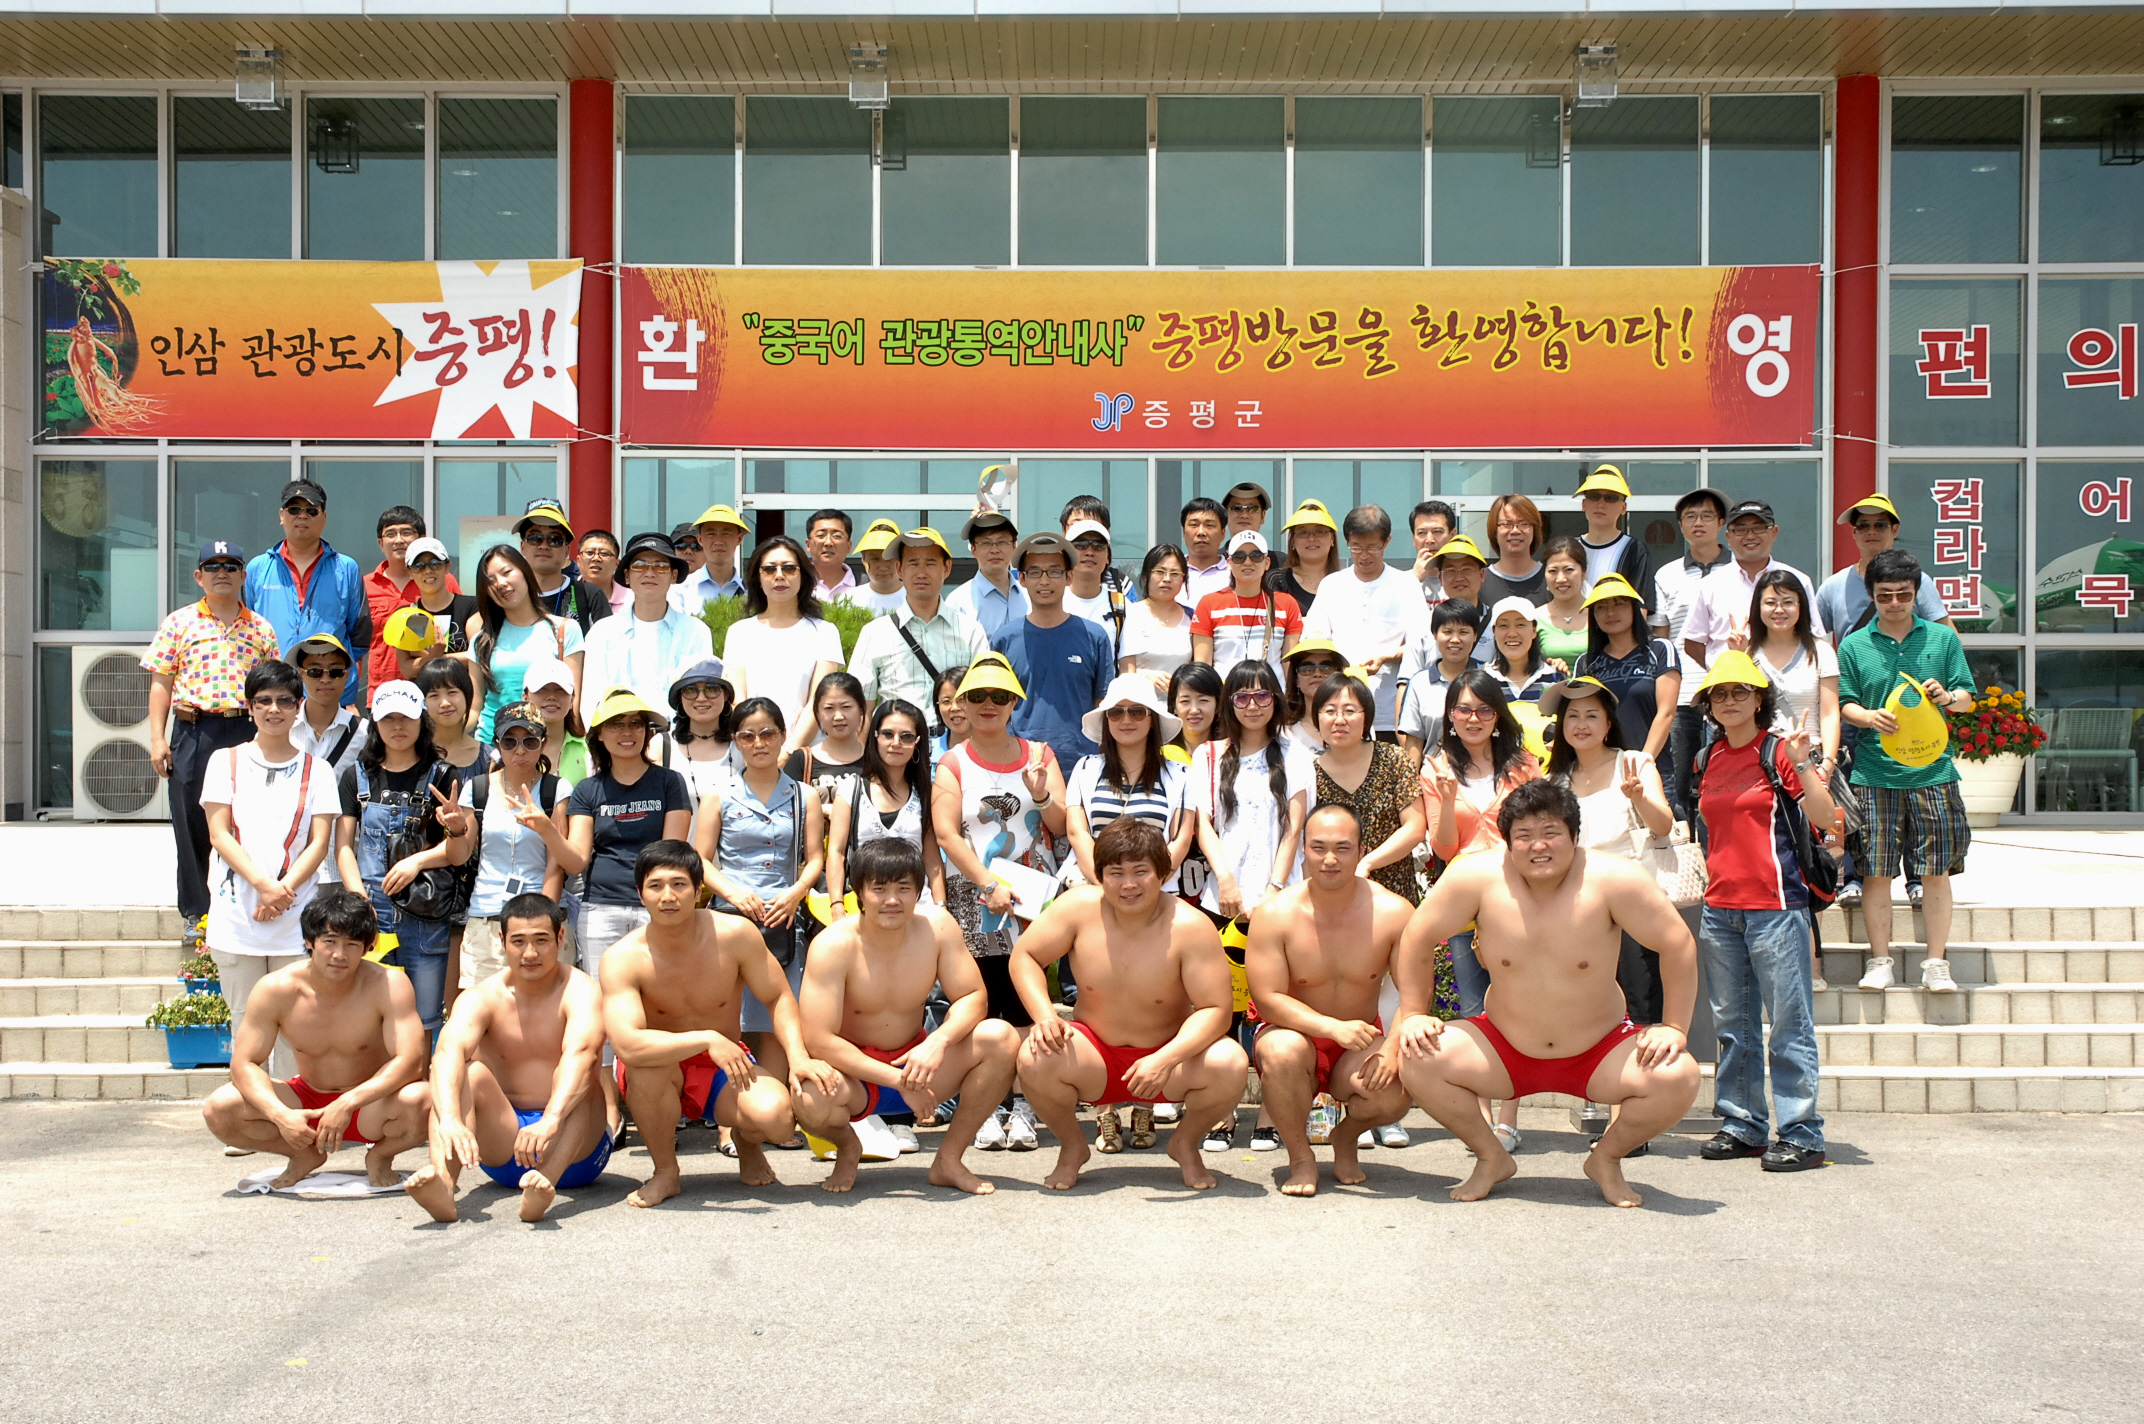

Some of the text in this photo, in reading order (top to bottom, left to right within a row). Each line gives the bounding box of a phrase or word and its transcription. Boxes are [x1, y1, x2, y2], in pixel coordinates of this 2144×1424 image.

[150, 327, 404, 377] 인삼 관광도시
[414, 309, 556, 389] 증평!
[638, 315, 706, 391] 환
[1150, 303, 1400, 379] 증평방문을
[1408, 301, 1696, 372] 환영합니다!
[1727, 313, 1792, 397] 영
[214, 541, 228, 554] K
[1930, 477, 1986, 618] 컵라면
[2075, 477, 2134, 618] 어묵
[375, 690, 418, 705] POLHAM
[628, 799, 662, 813] JEANS
